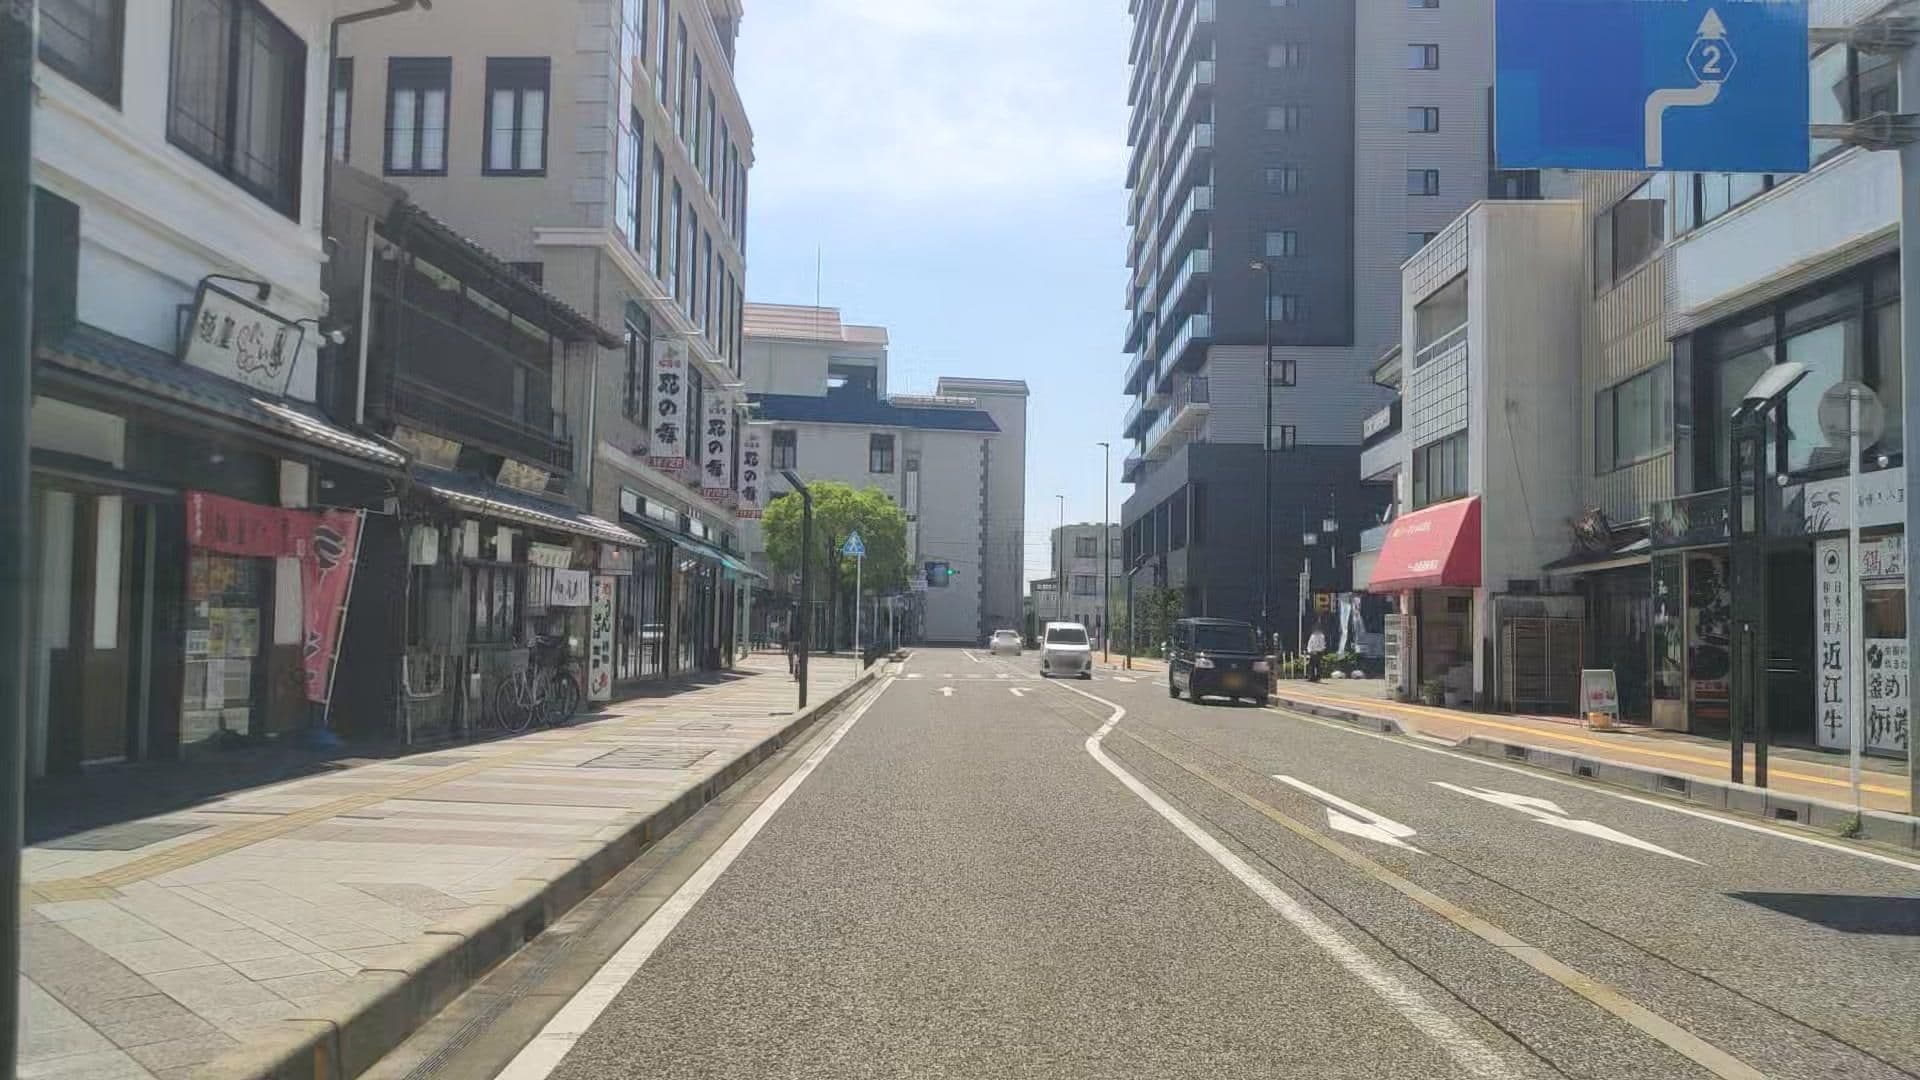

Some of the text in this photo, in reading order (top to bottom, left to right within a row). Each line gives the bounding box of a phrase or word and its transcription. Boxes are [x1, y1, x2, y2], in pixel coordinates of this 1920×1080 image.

[1702, 46, 1721, 74] 2
[1822, 640, 1844, 740] 近江牛
